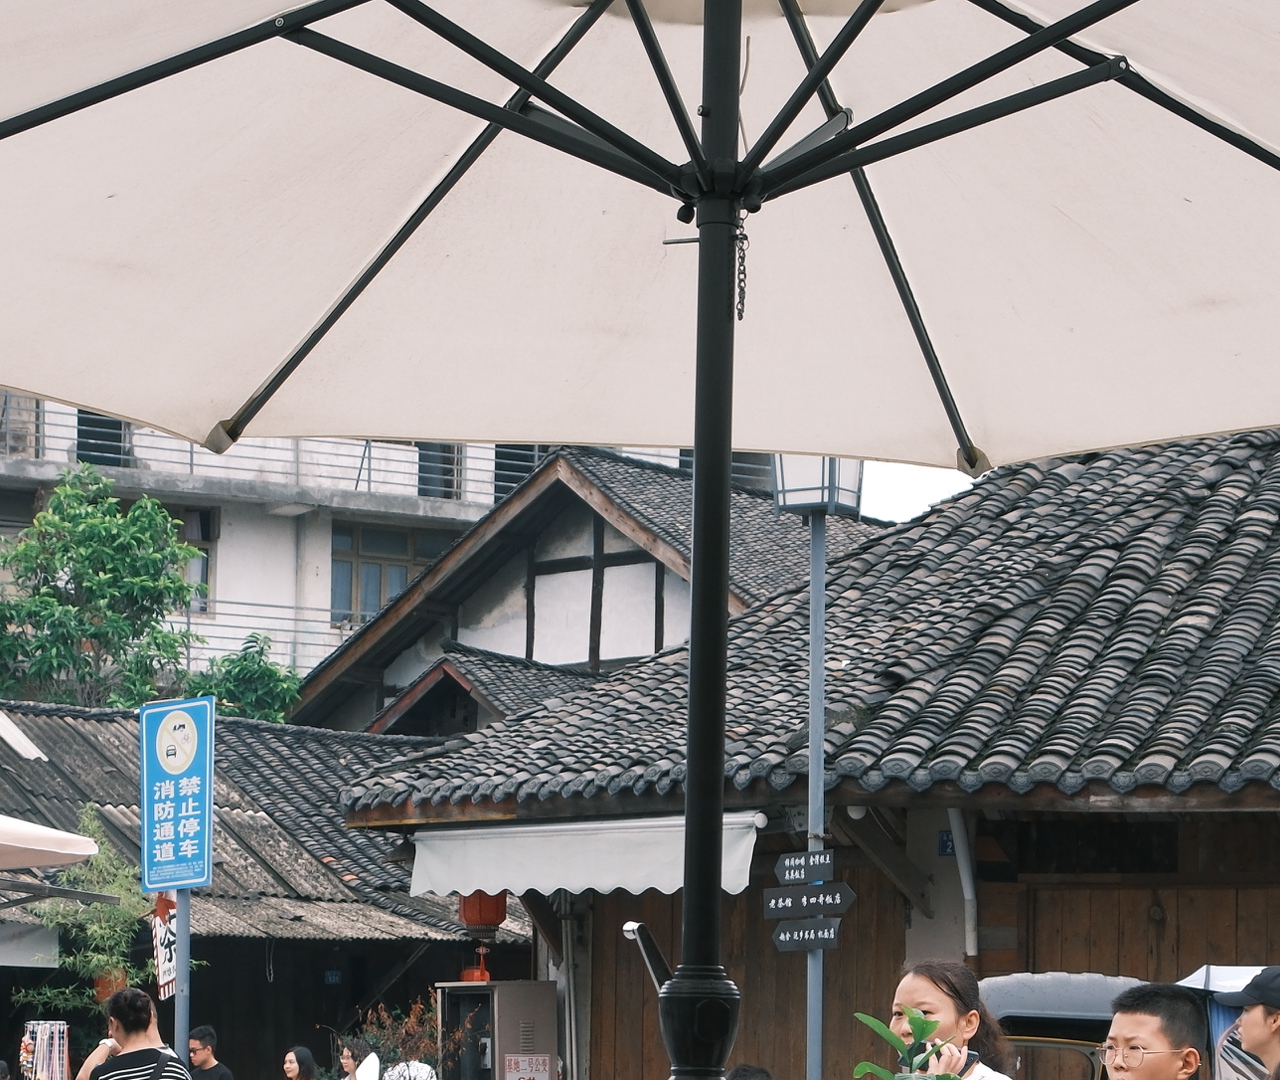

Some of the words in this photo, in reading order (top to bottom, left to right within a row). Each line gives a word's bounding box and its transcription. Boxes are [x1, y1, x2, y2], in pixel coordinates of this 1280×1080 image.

[153, 779, 175, 862] 消防通道
[177, 775, 202, 858] 禁止停车
